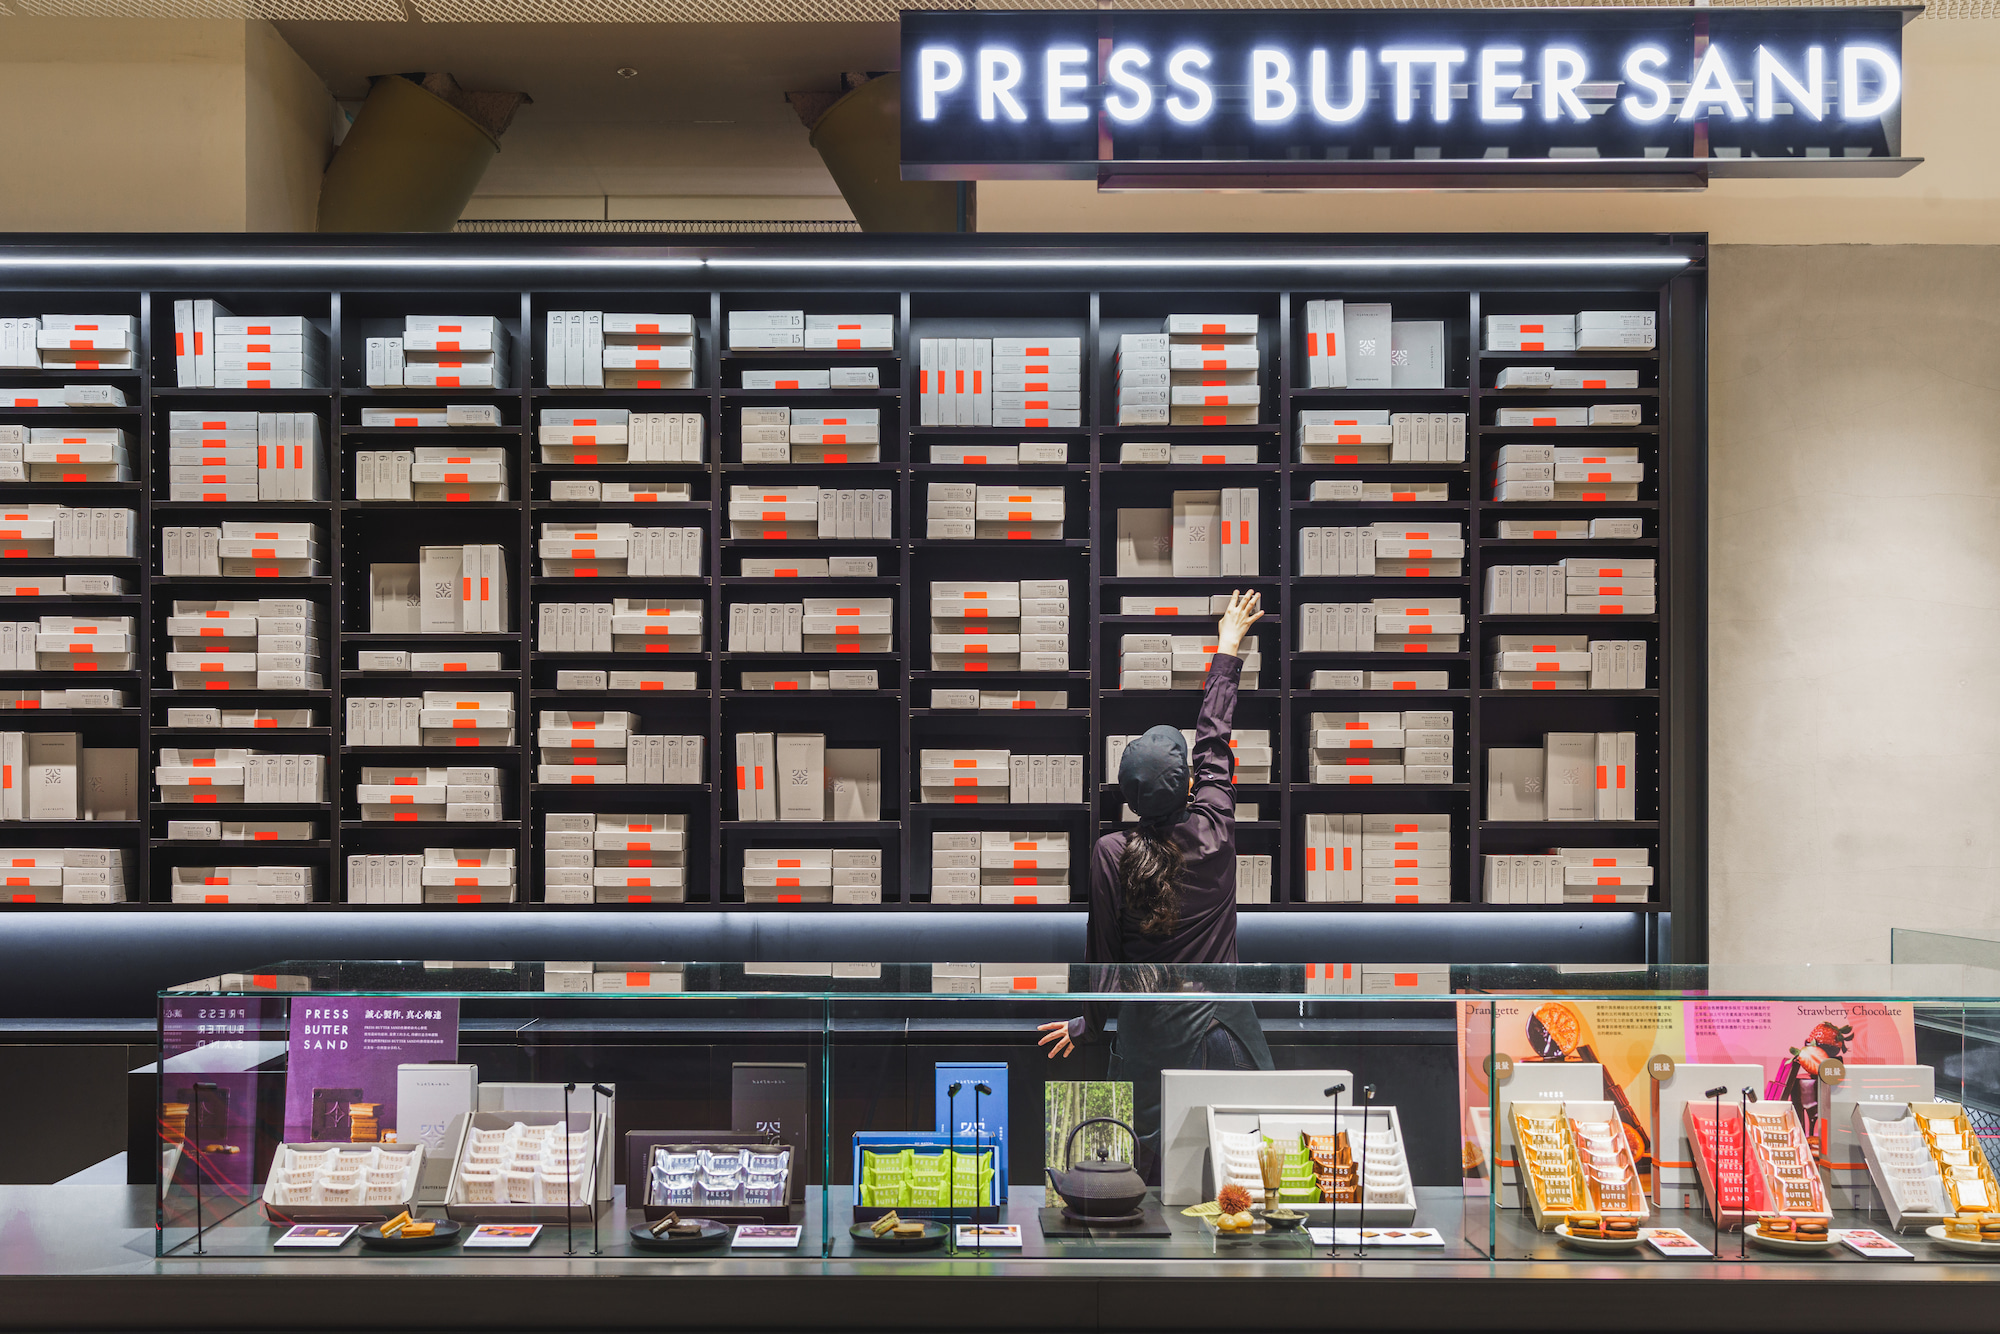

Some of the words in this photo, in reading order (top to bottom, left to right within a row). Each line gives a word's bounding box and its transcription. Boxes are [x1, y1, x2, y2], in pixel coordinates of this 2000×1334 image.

[919, 47, 1214, 122] PRESS
[1252, 47, 1592, 122] BUTTER
[1623, 44, 1901, 123] SAND
[553, 316, 562, 324] 15
[571, 316, 580, 324] 15
[590, 316, 598, 324] 15
[791, 316, 800, 325] 15
[1643, 316, 1652, 326] 15
[792, 334, 800, 343] 15
[1160, 338, 1166, 347] 9
[1643, 334, 1652, 343] 15
[868, 372, 874, 381] 9
[102, 390, 108, 399] 9
[485, 410, 491, 419] 9
[1632, 409, 1638, 418] 9
[780, 448, 786, 457] 9
[1058, 448, 1064, 457] 9
[1161, 448, 1167, 457] 9
[13, 466, 19, 475] 9
[1544, 468, 1550, 477] 9
[589, 485, 595, 494] 9
[1353, 485, 1359, 494] 9
[966, 506, 972, 515] 9
[1633, 523, 1639, 532] 9
[868, 561, 874, 570] 9
[104, 580, 110, 589] 9
[1059, 584, 1065, 594] 9
[296, 604, 302, 613] 9
[1162, 639, 1168, 648] 9
[868, 675, 874, 684] 9
[104, 694, 110, 704] 9
[969, 694, 975, 704] 9
[1443, 752, 1449, 761] 9
[484, 772, 490, 781] 9
[971, 836, 977, 846] 9
[295, 872, 301, 881] 9
[100, 890, 106, 899] 9
[583, 890, 589, 899] 9
[871, 890, 877, 899] 9
[305, 1009, 349, 1019] PRESS
[1797, 1006, 1849, 1019] Strawberry
[1852, 1006, 1902, 1016] Chocolate
[304, 1024, 348, 1035] BUTTER
[304, 1040, 348, 1050] SAND
